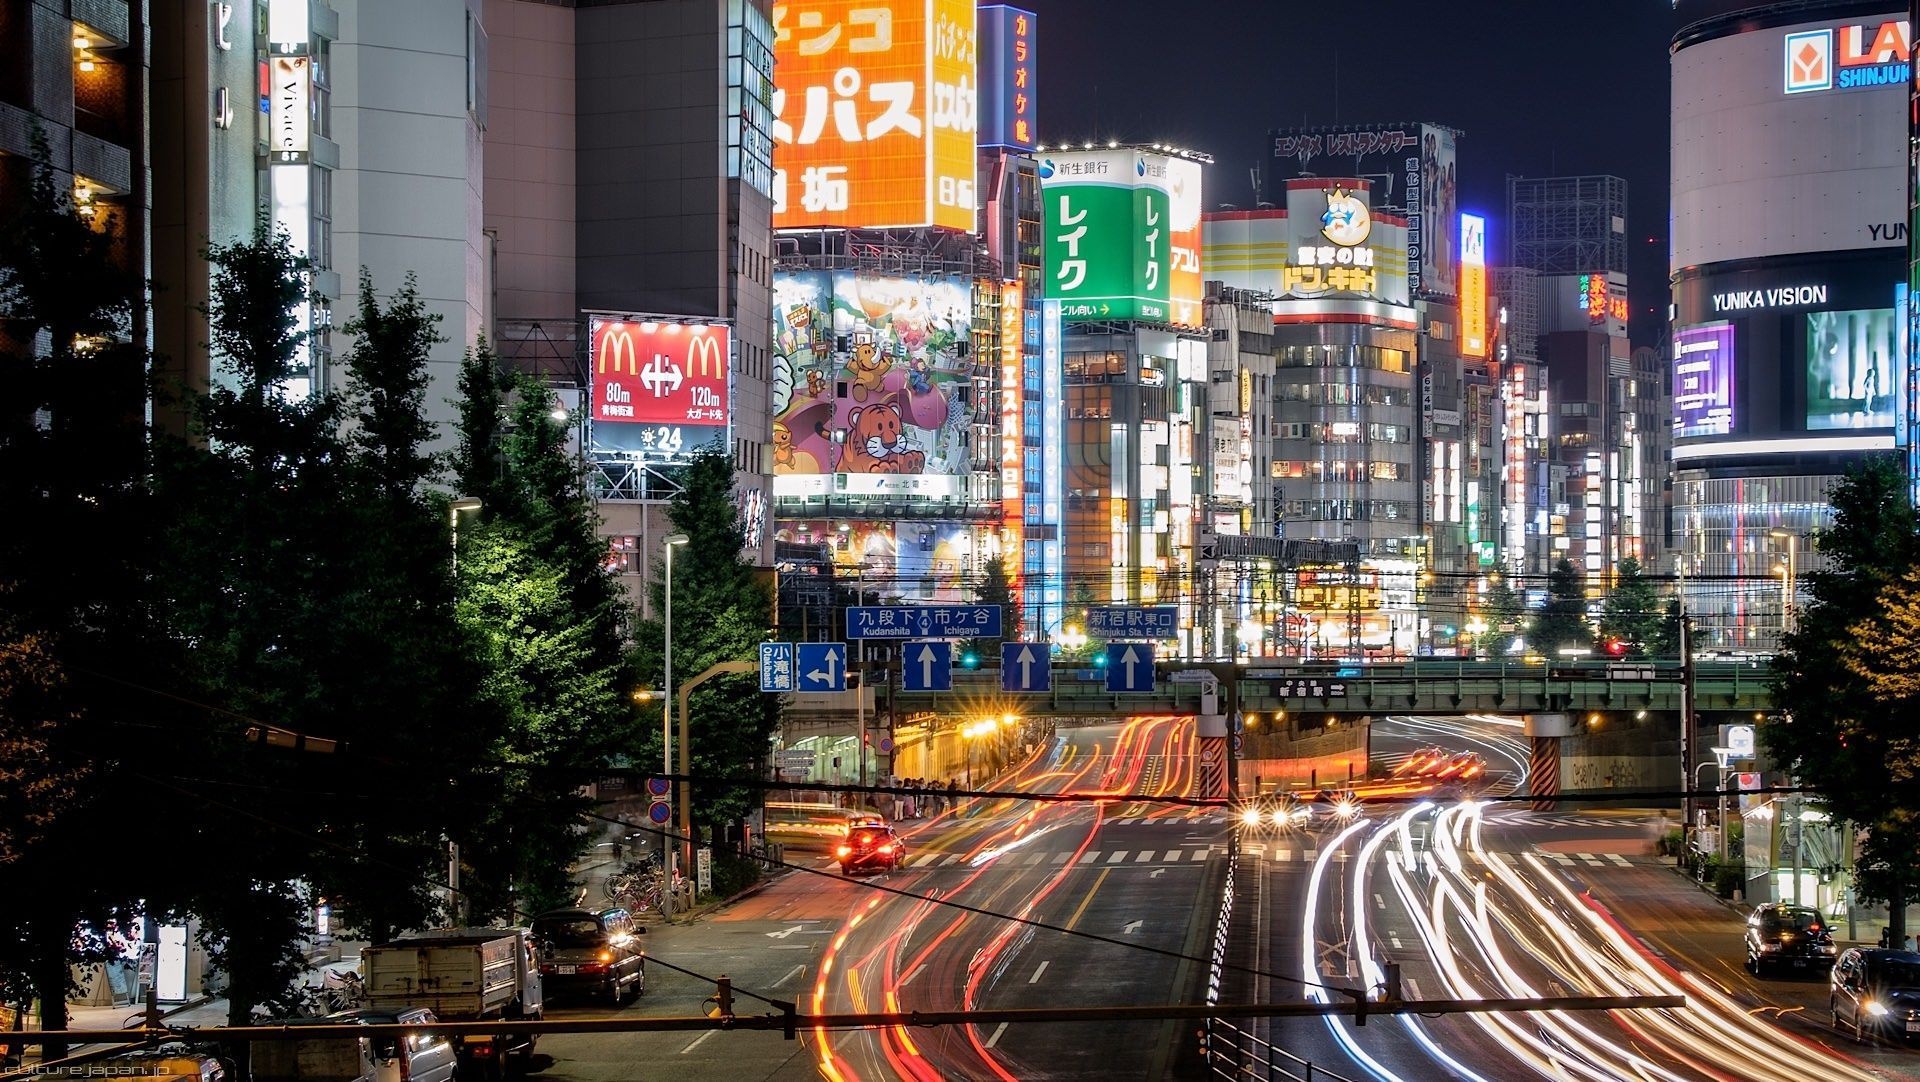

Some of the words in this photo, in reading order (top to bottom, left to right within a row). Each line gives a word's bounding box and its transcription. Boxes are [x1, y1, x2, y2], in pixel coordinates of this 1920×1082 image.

[284, 82, 297, 147] Vivace
[1059, 161, 1108, 176] 新生銀行
[1057, 195, 1088, 291] レイク
[1145, 196, 1159, 291] レイク
[1171, 246, 1200, 274] アコム
[1713, 290, 1765, 312] YUNIKA
[1767, 284, 1828, 305] VISION
[606, 383, 631, 403] 80m
[690, 386, 720, 407] 120m
[686, 408, 723, 421] 大ガード先
[658, 426, 683, 450] 24
[858, 609, 915, 626] 九段下
[921, 618, 928, 627] 4
[1091, 610, 1172, 627] 新宿駅東口
[862, 626, 911, 636] Kudanshita
[944, 625, 980, 637] Ichigaya
[1092, 627, 1126, 638] Shinjuku
[1128, 627, 1144, 637] Sta.
[763, 646, 772, 688] Otakibashi
[773, 645, 790, 689] 小滝橋
[1279, 686, 1324, 697] 新宿駅
